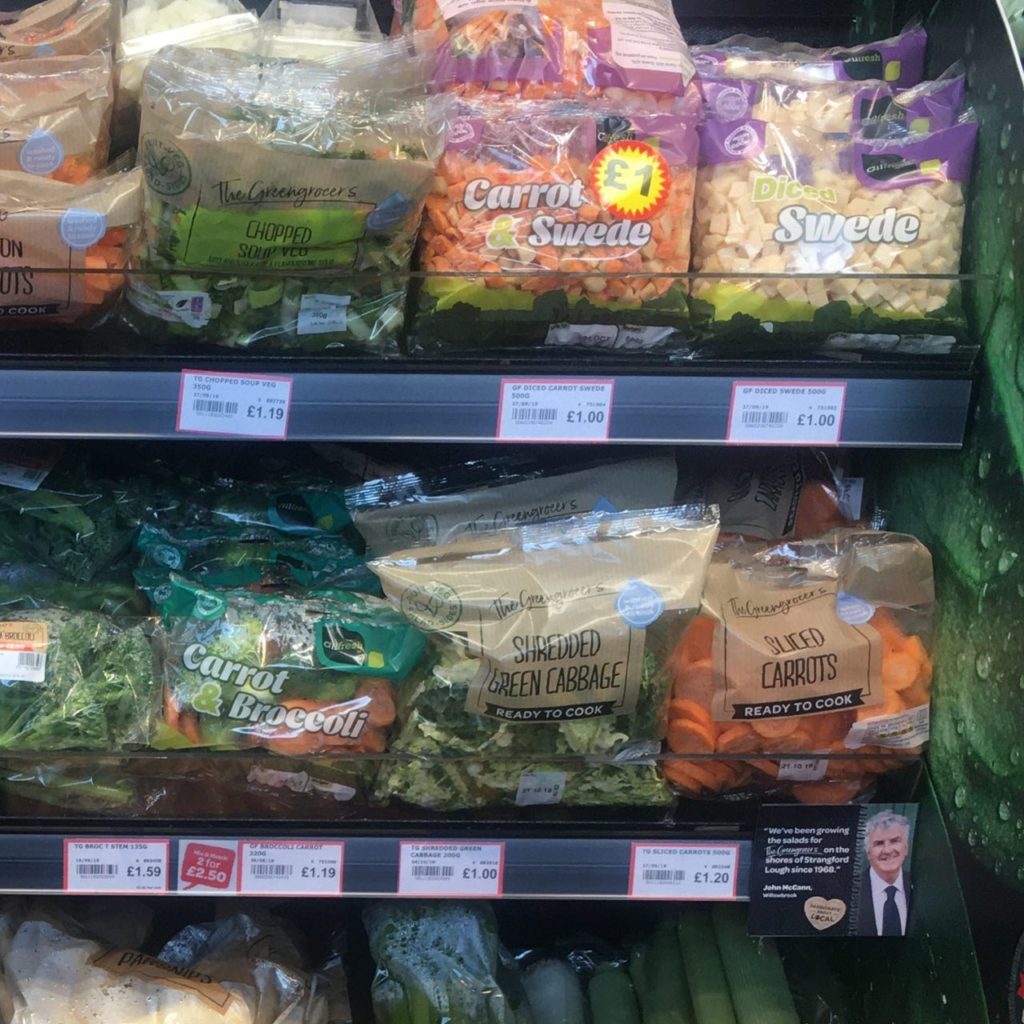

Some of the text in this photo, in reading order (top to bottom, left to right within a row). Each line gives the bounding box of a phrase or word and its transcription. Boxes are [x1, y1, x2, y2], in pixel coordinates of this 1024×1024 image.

[603, 156, 654, 199] £1
[212, 179, 241, 205] The
[463, 177, 585, 212] Carrot
[752, 175, 837, 204] Diced
[246, 219, 312, 245] CHOPPED
[485, 214, 652, 249] & Swede
[775, 206, 921, 245] Swede
[238, 243, 308, 260] SOUP VEG
[6, 304, 46, 314] COOK
[247, 406, 284, 419] £1.19
[567, 411, 604, 423] £1.00
[797, 414, 835, 426] £1.00
[512, 629, 602, 664] SHREDDED
[764, 627, 826, 656] SLICED
[182, 643, 289, 694] Carrot
[488, 661, 624, 698] GREEN CABBAGE
[761, 653, 838, 690] CARROTS
[191, 682, 369, 740] & Broccoli
[496, 706, 604, 719] READY TO COOK
[744, 694, 853, 717] READY TO COOK
[127, 866, 161, 877] £1.59
[206, 859, 221, 868] for
[765, 856, 850, 865] shores of Strangford
[186, 867, 226, 882] £2.50
[302, 867, 335, 878] £1.19
[463, 869, 497, 880] £1.00
[695, 872, 729, 884] £1.20
